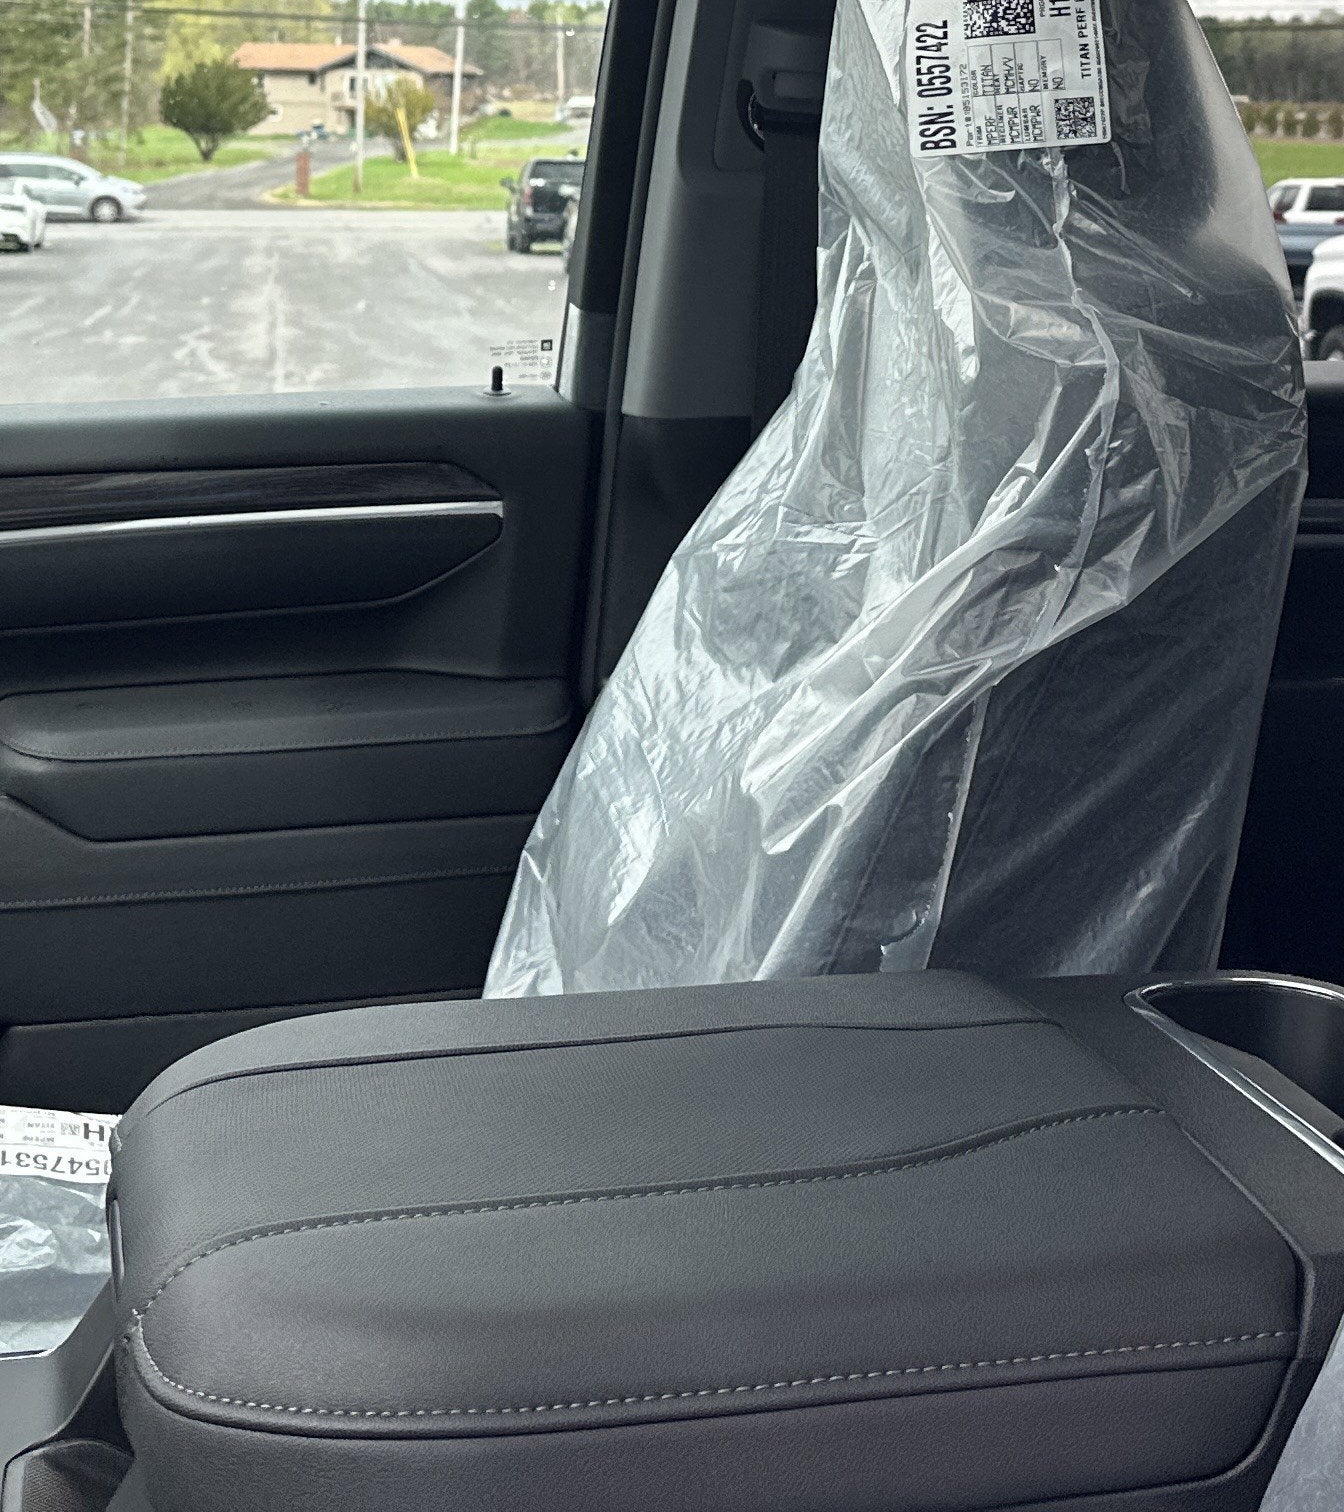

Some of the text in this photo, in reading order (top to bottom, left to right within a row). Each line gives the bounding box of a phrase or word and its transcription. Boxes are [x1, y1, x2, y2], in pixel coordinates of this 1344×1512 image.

[1075, 7, 1088, 39] PERF
[916, 20, 953, 97] 0557422
[1040, 55, 1049, 90] MEMORY
[1078, 43, 1092, 79] TITAN
[980, 64, 994, 95] TITAN
[1027, 78, 1040, 92] NO
[1052, 76, 1064, 90] NO
[920, 104, 956, 151] BSN:
